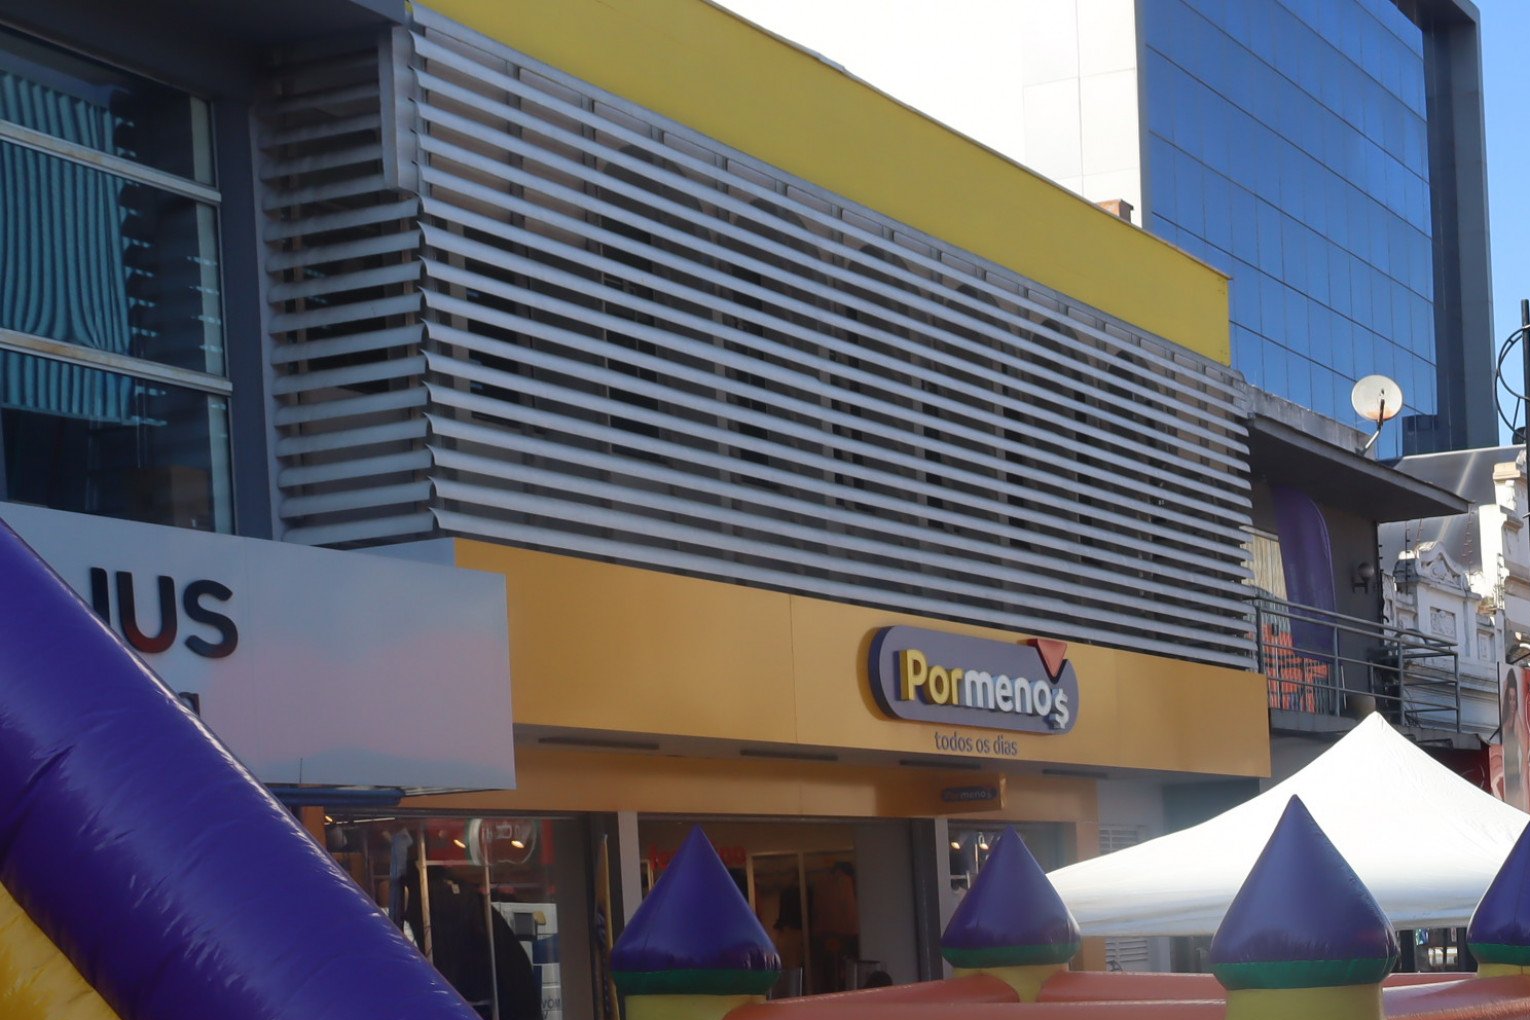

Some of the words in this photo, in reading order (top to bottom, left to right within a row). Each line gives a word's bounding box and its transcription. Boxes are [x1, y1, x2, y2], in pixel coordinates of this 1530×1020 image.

[934, 731, 973, 752] todos
[975, 737, 991, 753] os
[993, 735, 1018, 756] dias
